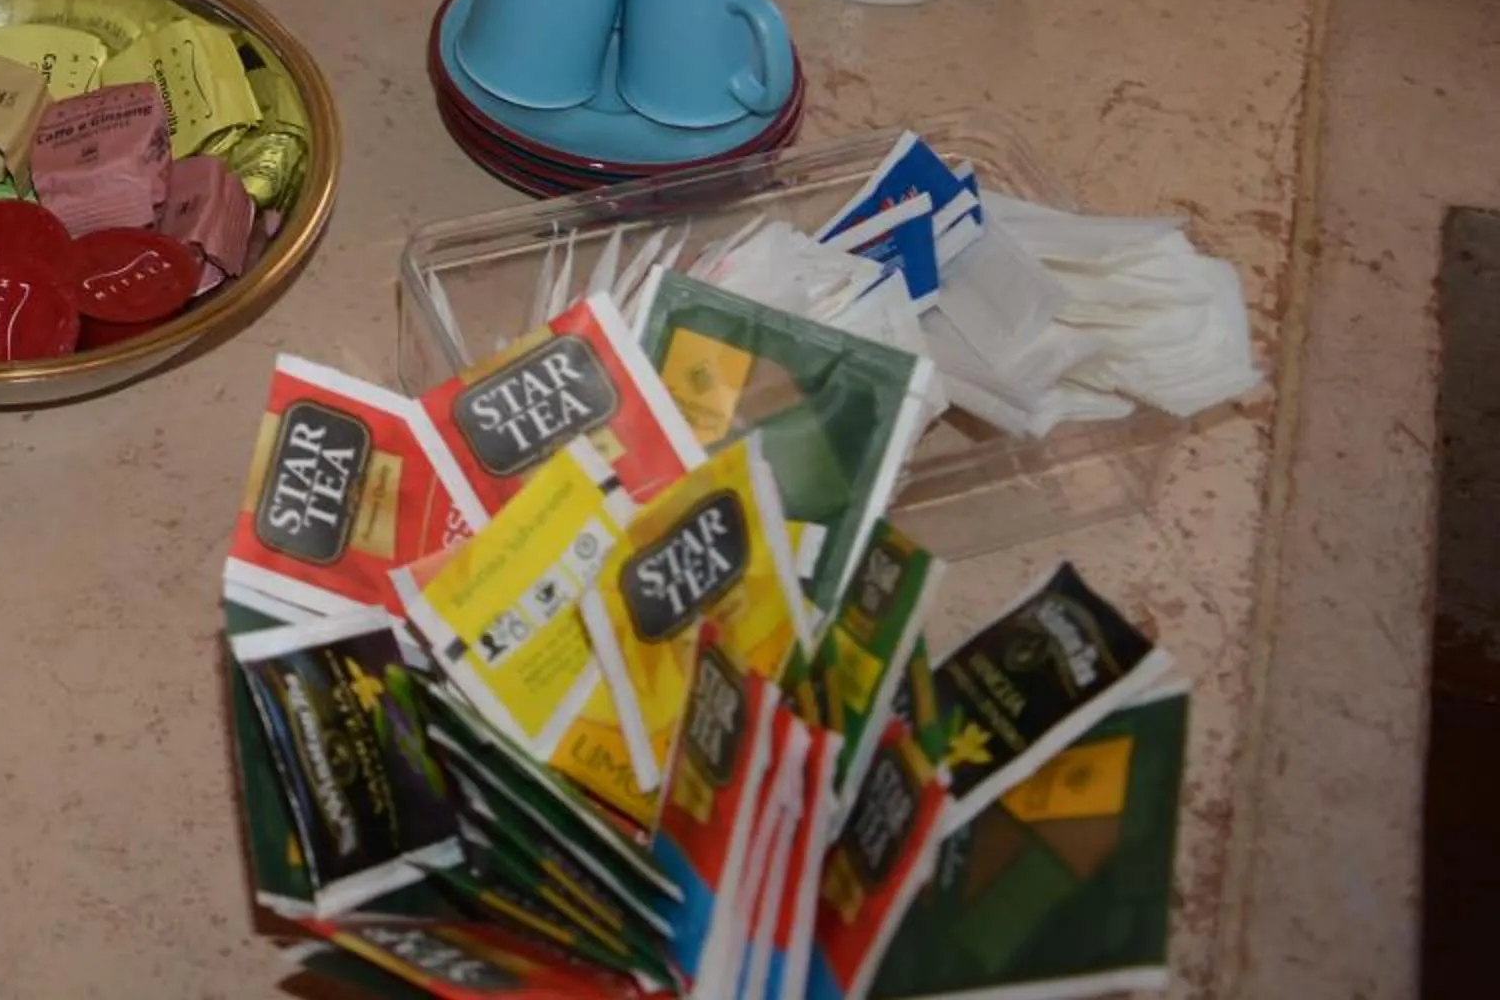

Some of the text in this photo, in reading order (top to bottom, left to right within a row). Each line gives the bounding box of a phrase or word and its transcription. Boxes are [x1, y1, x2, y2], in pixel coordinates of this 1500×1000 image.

[470, 348, 583, 433] STAR
[495, 387, 592, 454] TEA
[268, 420, 328, 537] STAR
[302, 441, 356, 530] TEA
[634, 506, 730, 600] STAR
[661, 550, 733, 617] TEA
